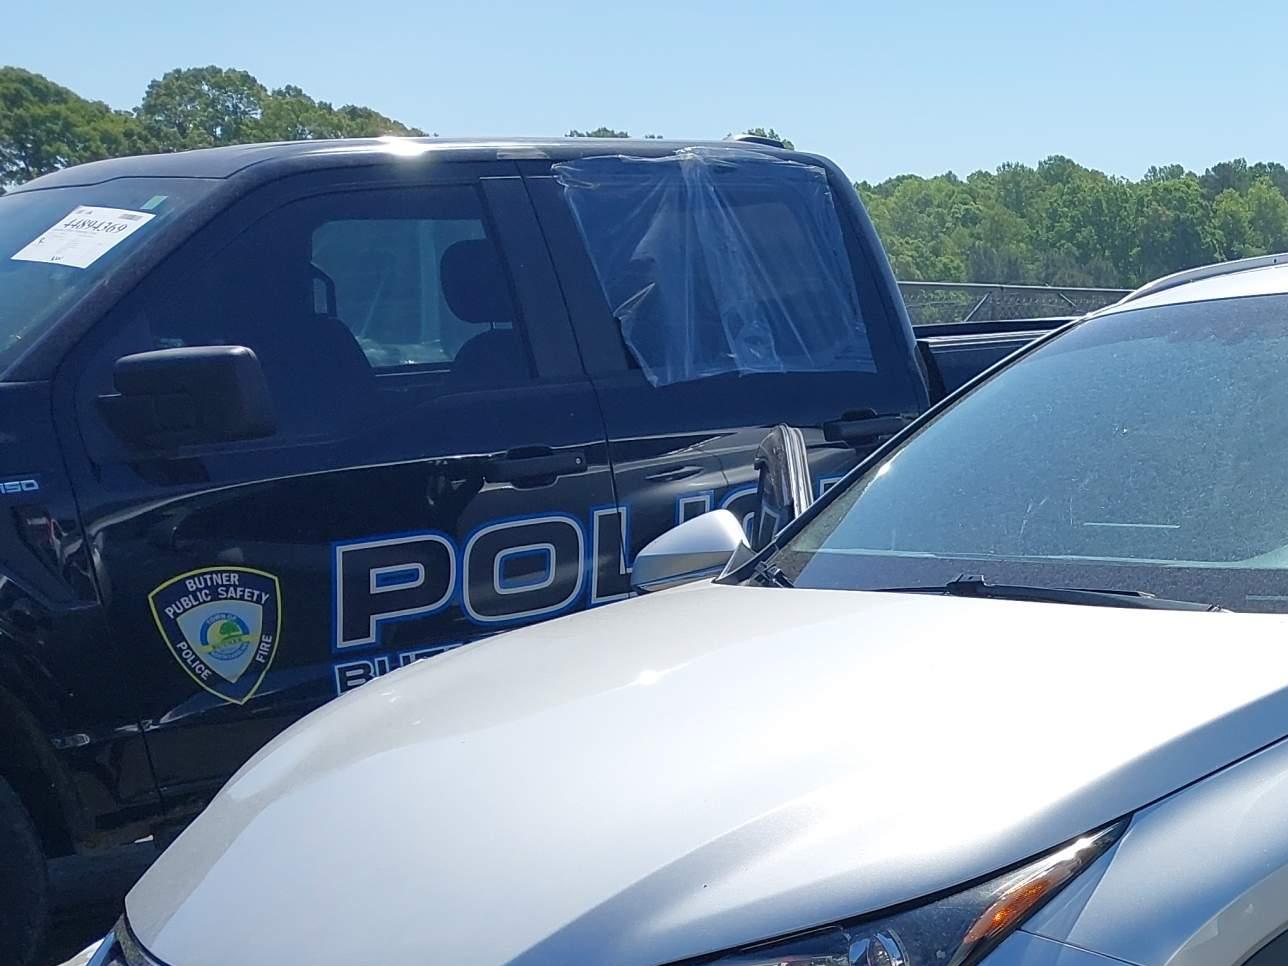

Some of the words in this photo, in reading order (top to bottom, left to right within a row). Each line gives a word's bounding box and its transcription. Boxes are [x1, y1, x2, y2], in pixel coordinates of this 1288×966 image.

[64, 219, 128, 233] 44894369
[185, 573, 239, 592] BUTNER
[164, 589, 211, 619] PUBLIC
[218, 587, 269, 605] SAFETY
[176, 641, 212, 680] POLICE
[255, 634, 272, 663] FIRE
